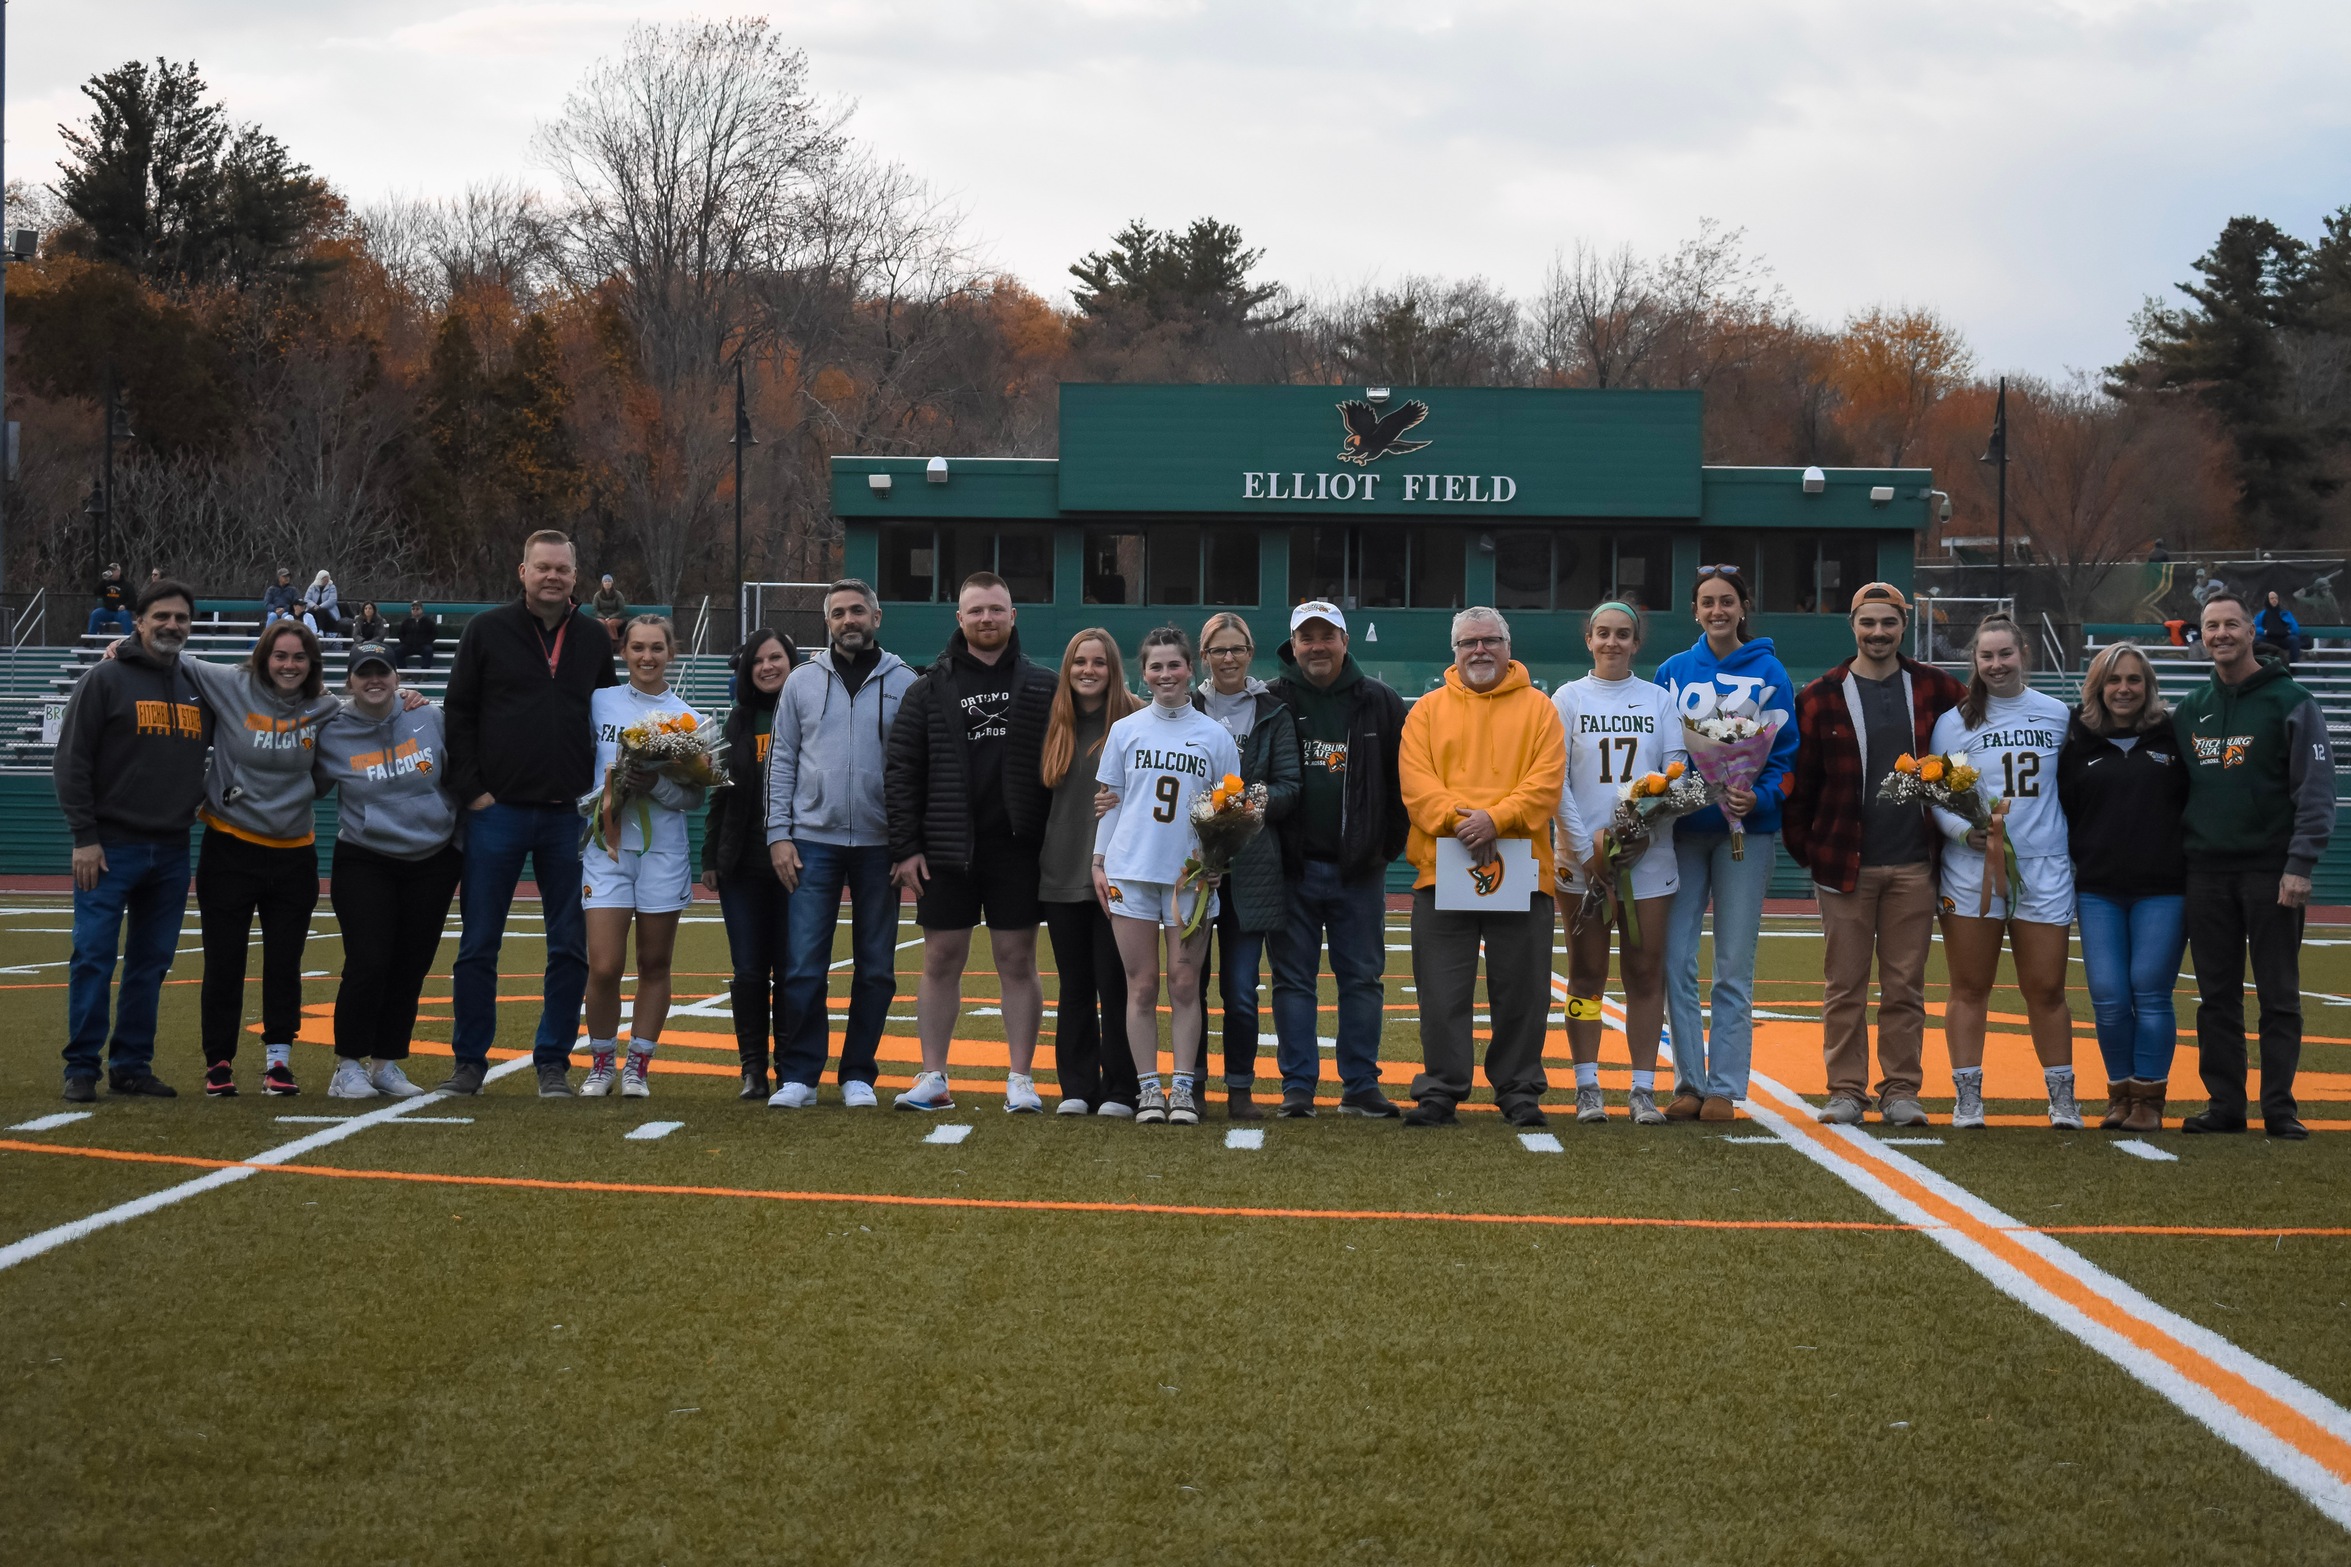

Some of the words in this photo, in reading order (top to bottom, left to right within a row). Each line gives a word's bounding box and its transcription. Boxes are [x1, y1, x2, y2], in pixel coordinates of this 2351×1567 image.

[1242, 472, 1380, 500] ELLIOT
[1402, 474, 1517, 502] FIELD
[46, 706, 65, 720] BR
[1579, 714, 1655, 734] FALCONS
[1982, 729, 2054, 749] FALCONS
[2312, 743, 2326, 760] 12
[366, 746, 434, 782] FALCONS
[1135, 749, 1207, 778] FALCONS
[1598, 737, 1639, 784] 17
[2001, 751, 2040, 798] 12
[1152, 775, 1181, 825] 9
[1568, 998, 1583, 1017] C
